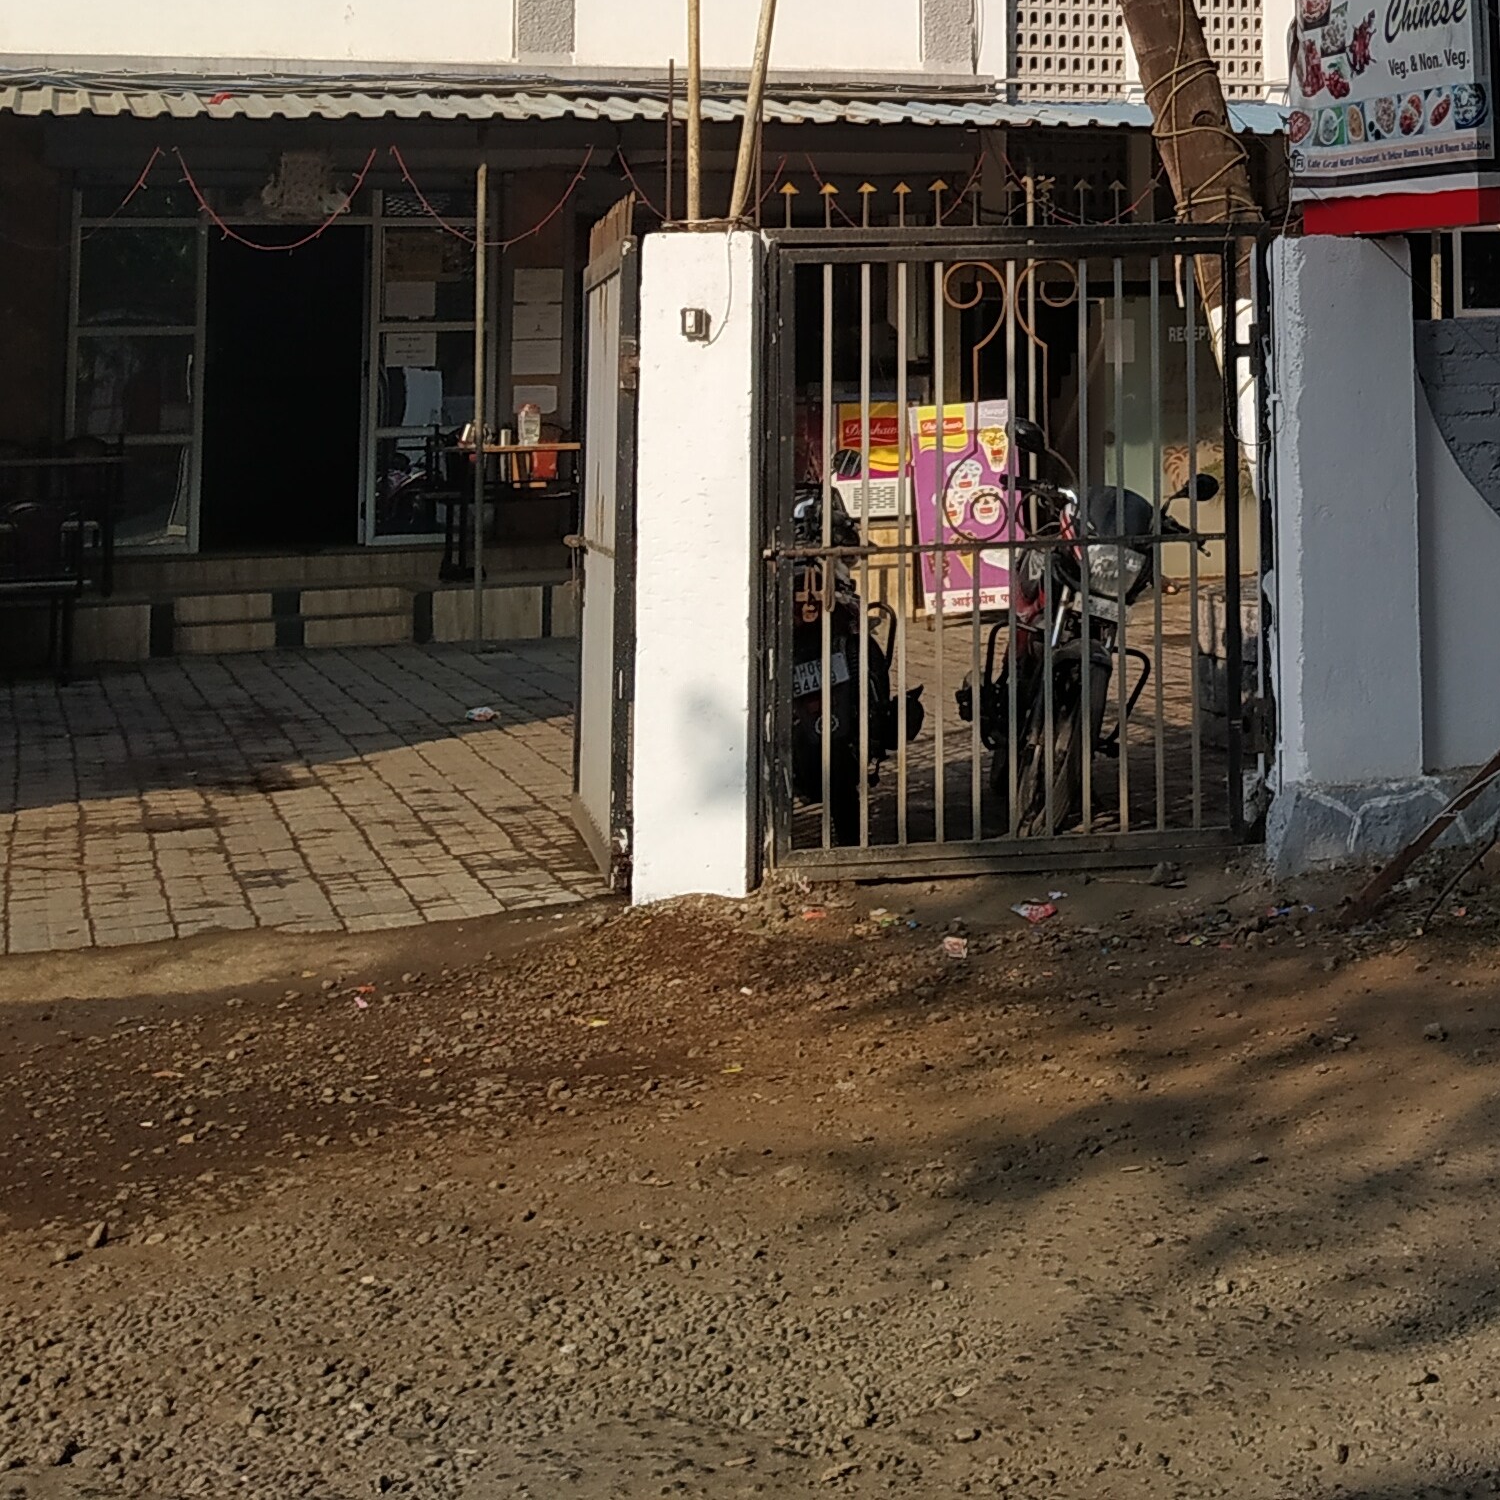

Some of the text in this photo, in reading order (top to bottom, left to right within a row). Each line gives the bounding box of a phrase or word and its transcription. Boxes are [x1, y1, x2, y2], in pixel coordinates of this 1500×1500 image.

[1388, 49, 1471, 79] Veg. & Non. Veg.
